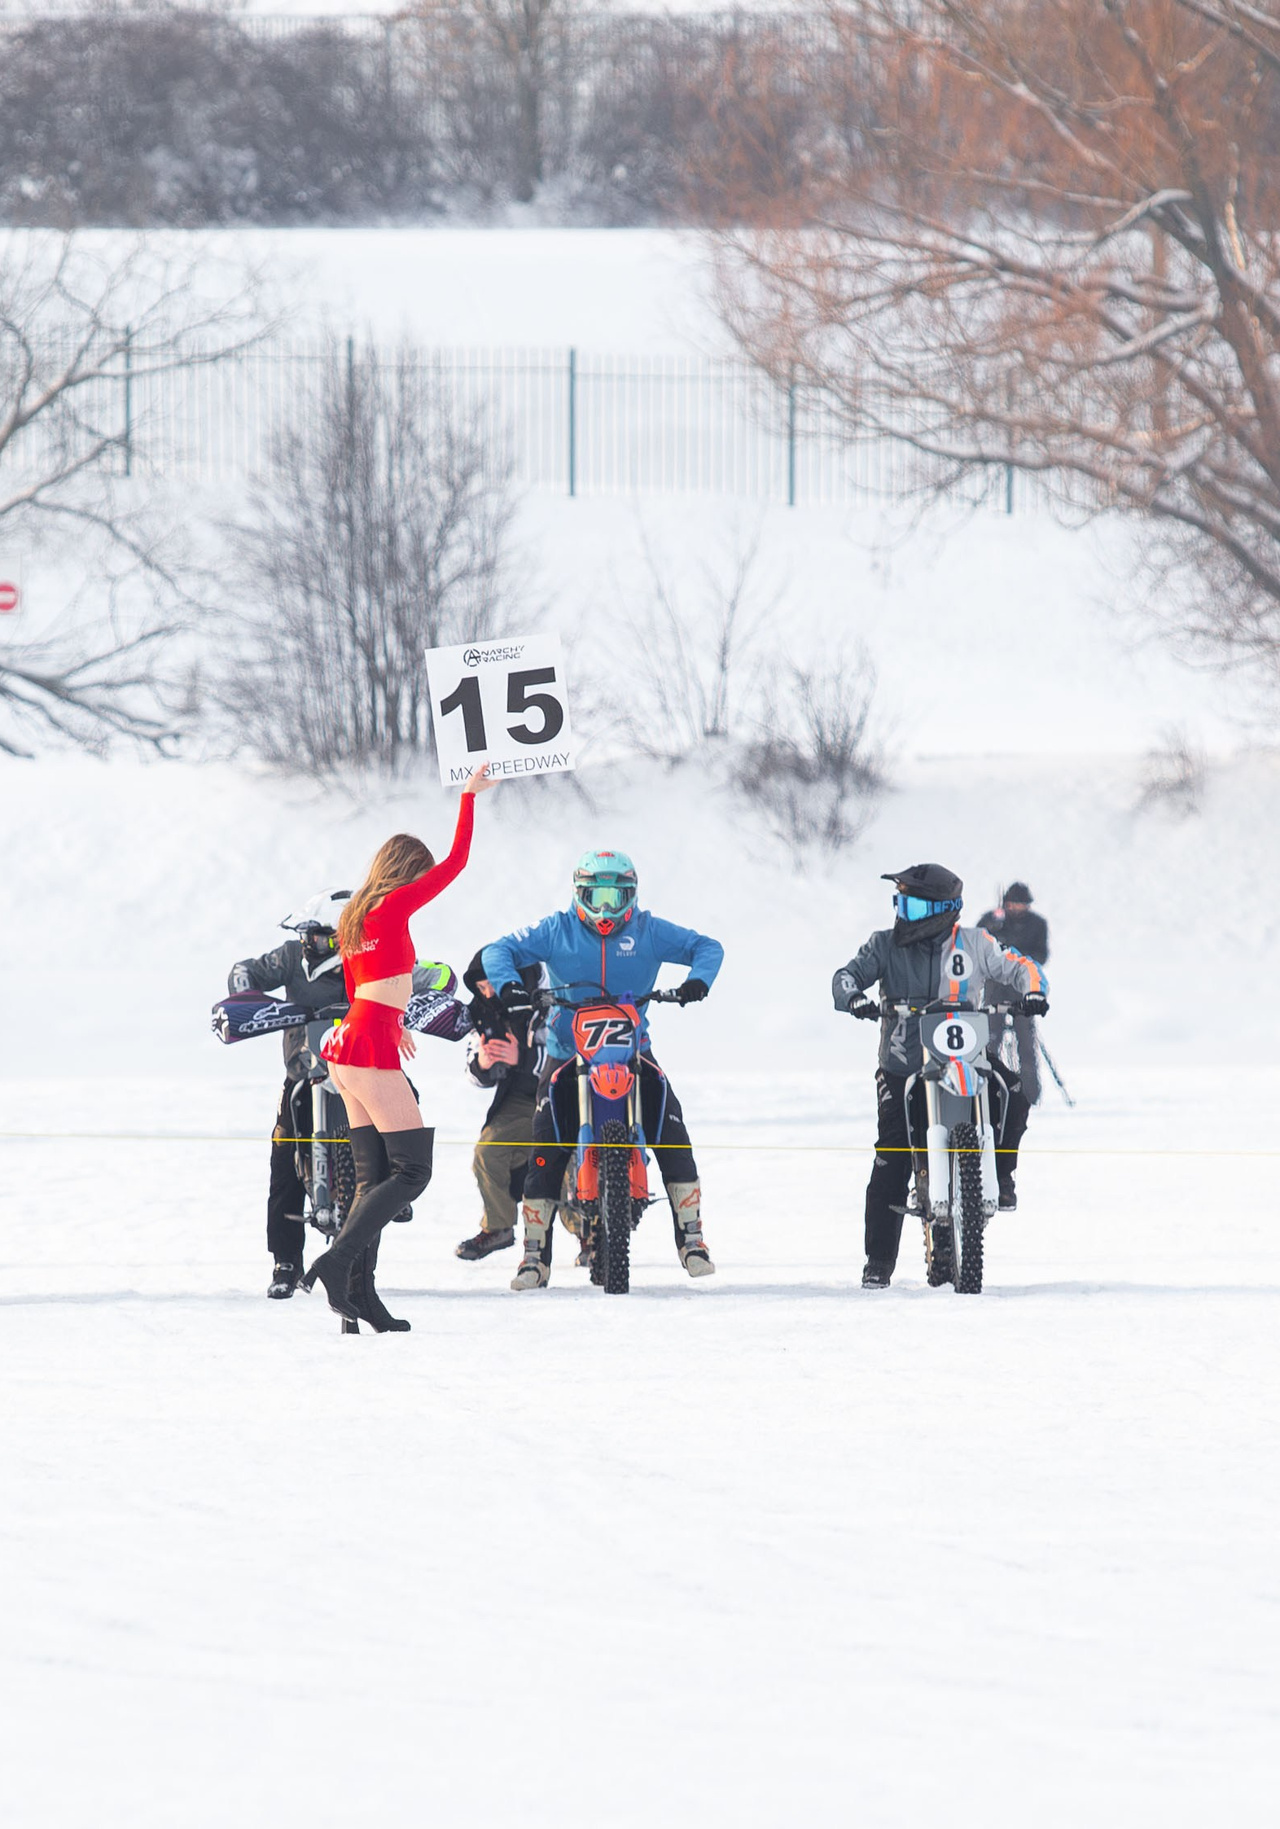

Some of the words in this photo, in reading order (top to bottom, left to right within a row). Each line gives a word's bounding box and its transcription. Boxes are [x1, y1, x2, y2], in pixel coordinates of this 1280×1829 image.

[479, 652, 521, 663] RACING
[439, 666, 564, 753] 15
[450, 766, 473, 782] MX
[951, 953, 965, 976] 8
[582, 1017, 633, 1050] 72
[946, 1025, 965, 1050] 8
